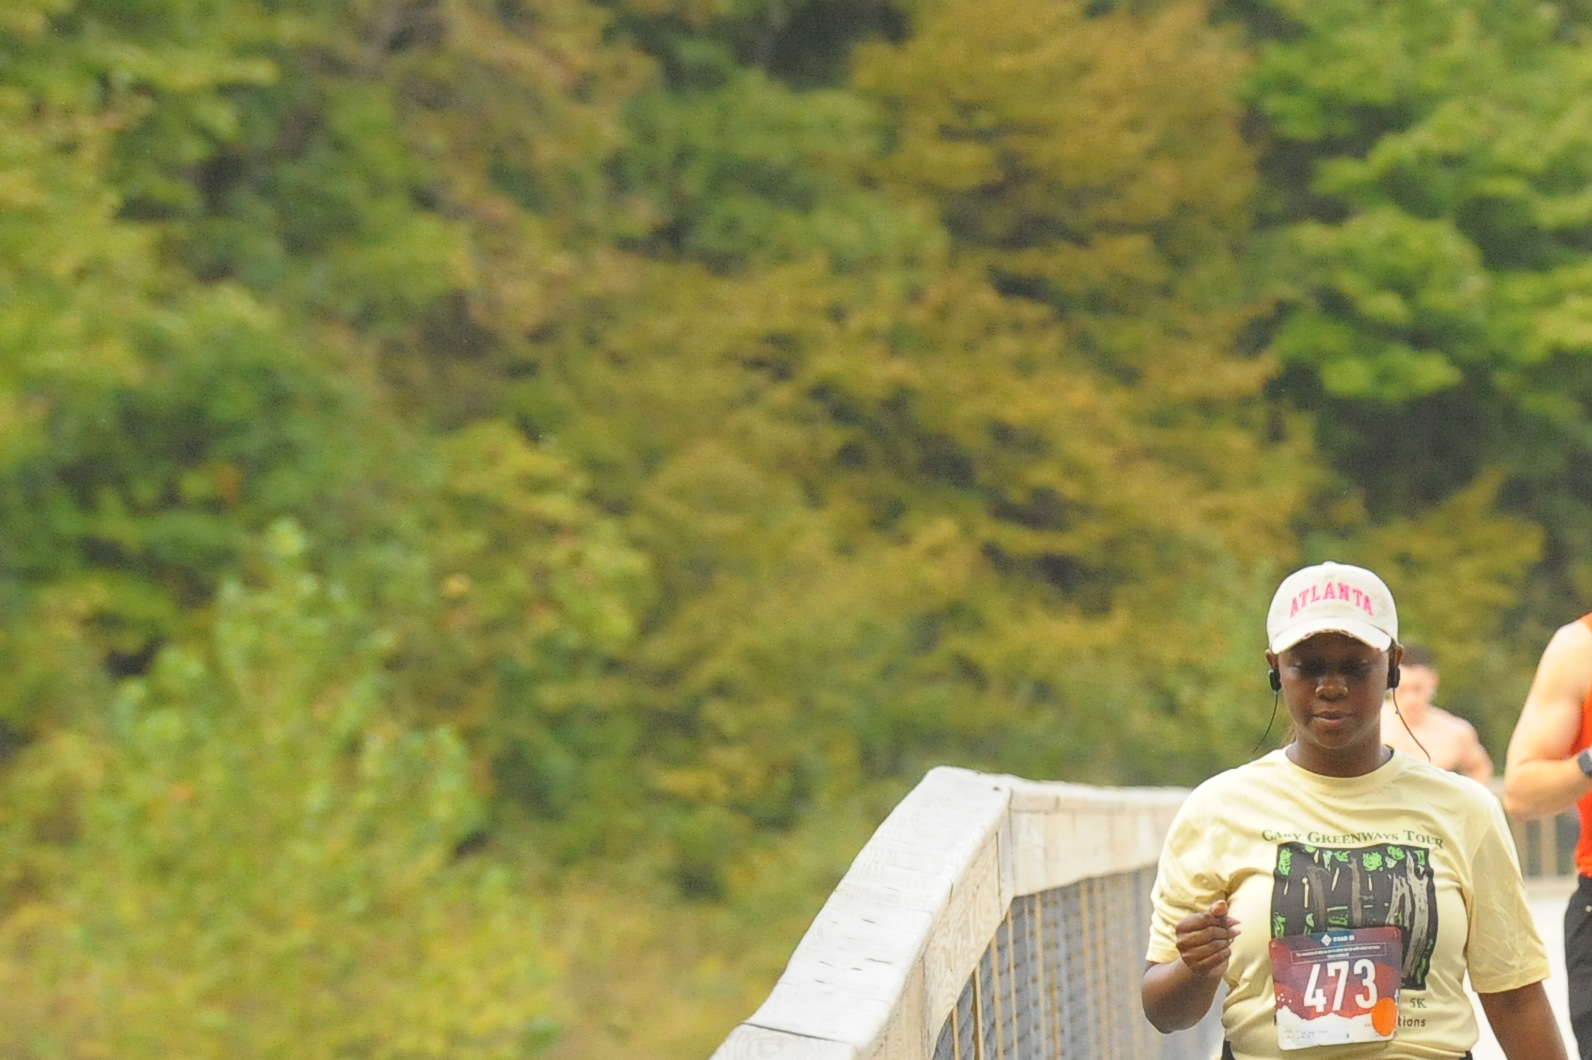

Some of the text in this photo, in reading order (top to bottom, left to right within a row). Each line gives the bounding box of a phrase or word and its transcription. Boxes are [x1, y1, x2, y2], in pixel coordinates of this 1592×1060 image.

[1289, 582, 1374, 619] ATLANTA
[1402, 829, 1444, 848] TOUR
[1303, 958, 1378, 1012] 473
[1409, 997, 1427, 1009] 5K
